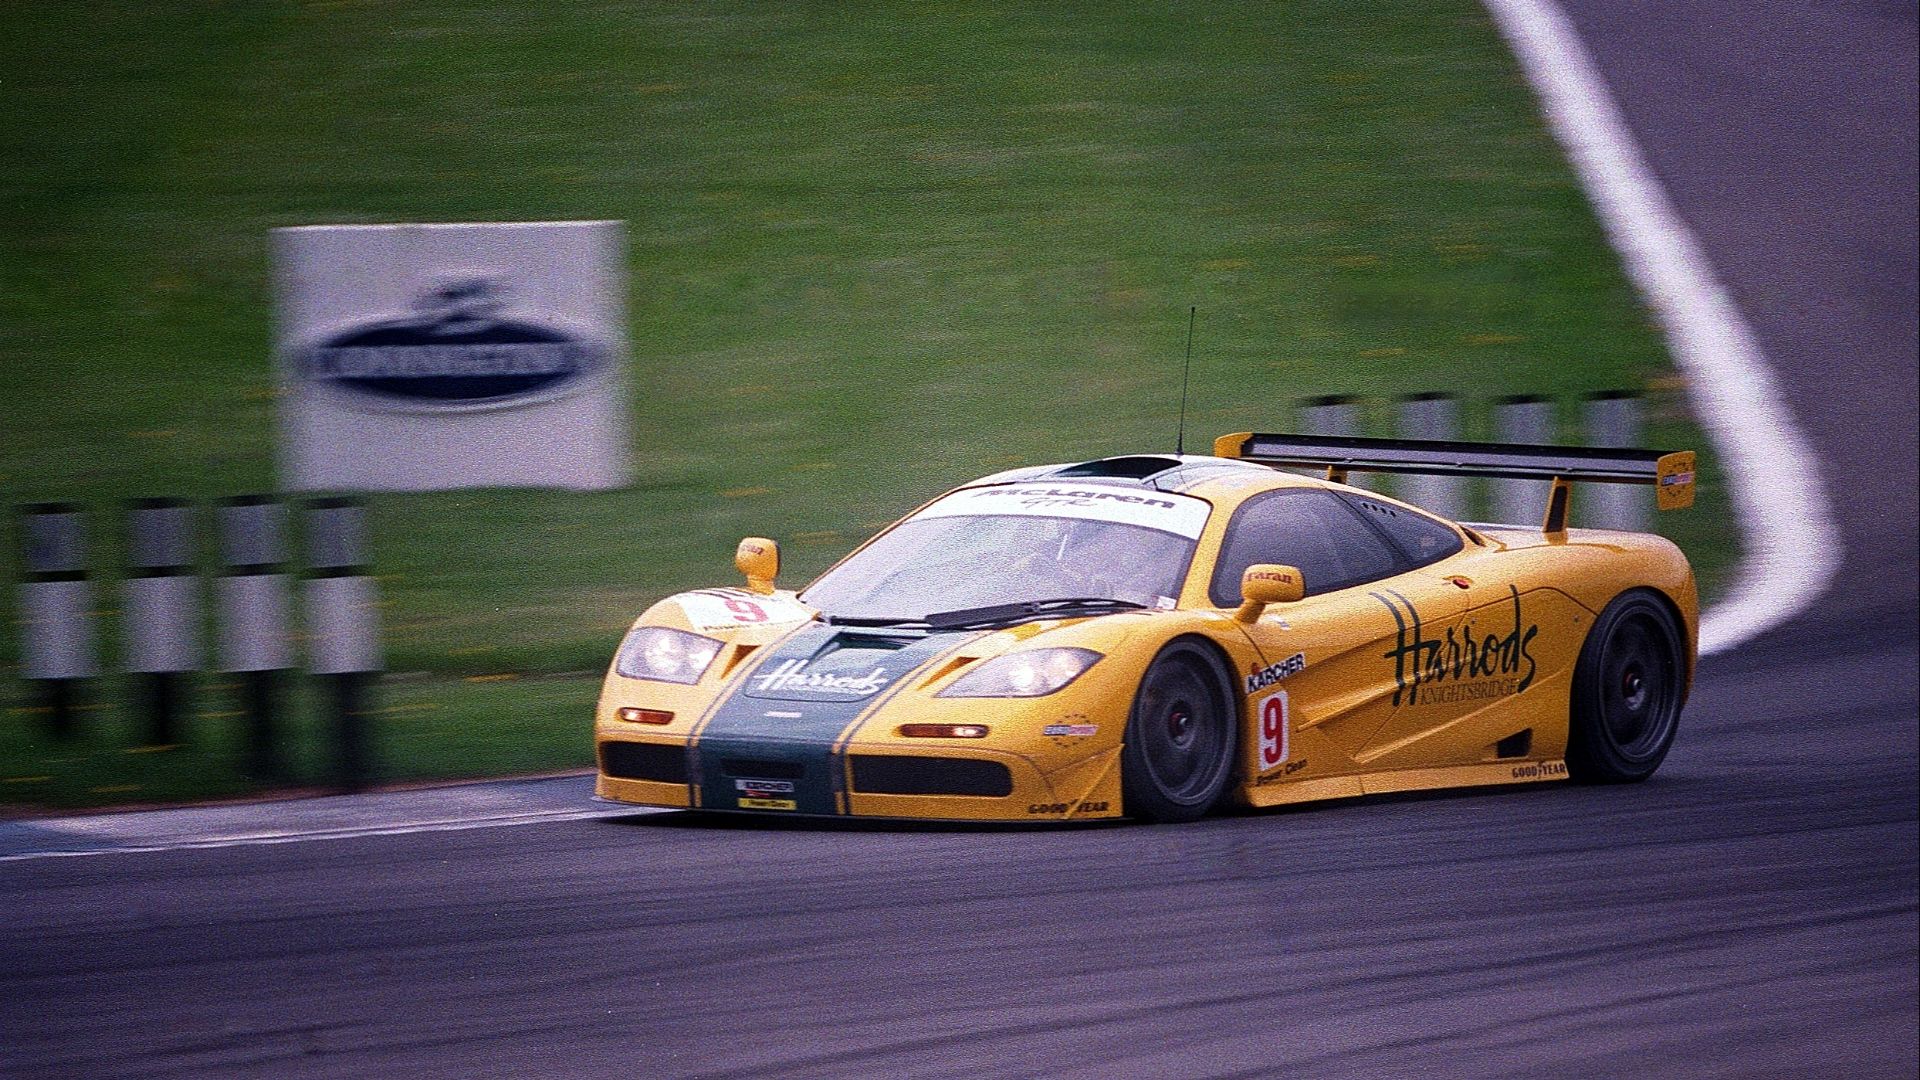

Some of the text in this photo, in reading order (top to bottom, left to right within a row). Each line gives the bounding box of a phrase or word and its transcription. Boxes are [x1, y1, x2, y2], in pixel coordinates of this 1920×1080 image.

[724, 599, 769, 622] 9
[1369, 584, 1538, 706] Harrods
[753, 658, 890, 695] Harrods
[1419, 678, 1520, 706] KNIGHTSBRIDGE
[1263, 697, 1284, 764] 9
